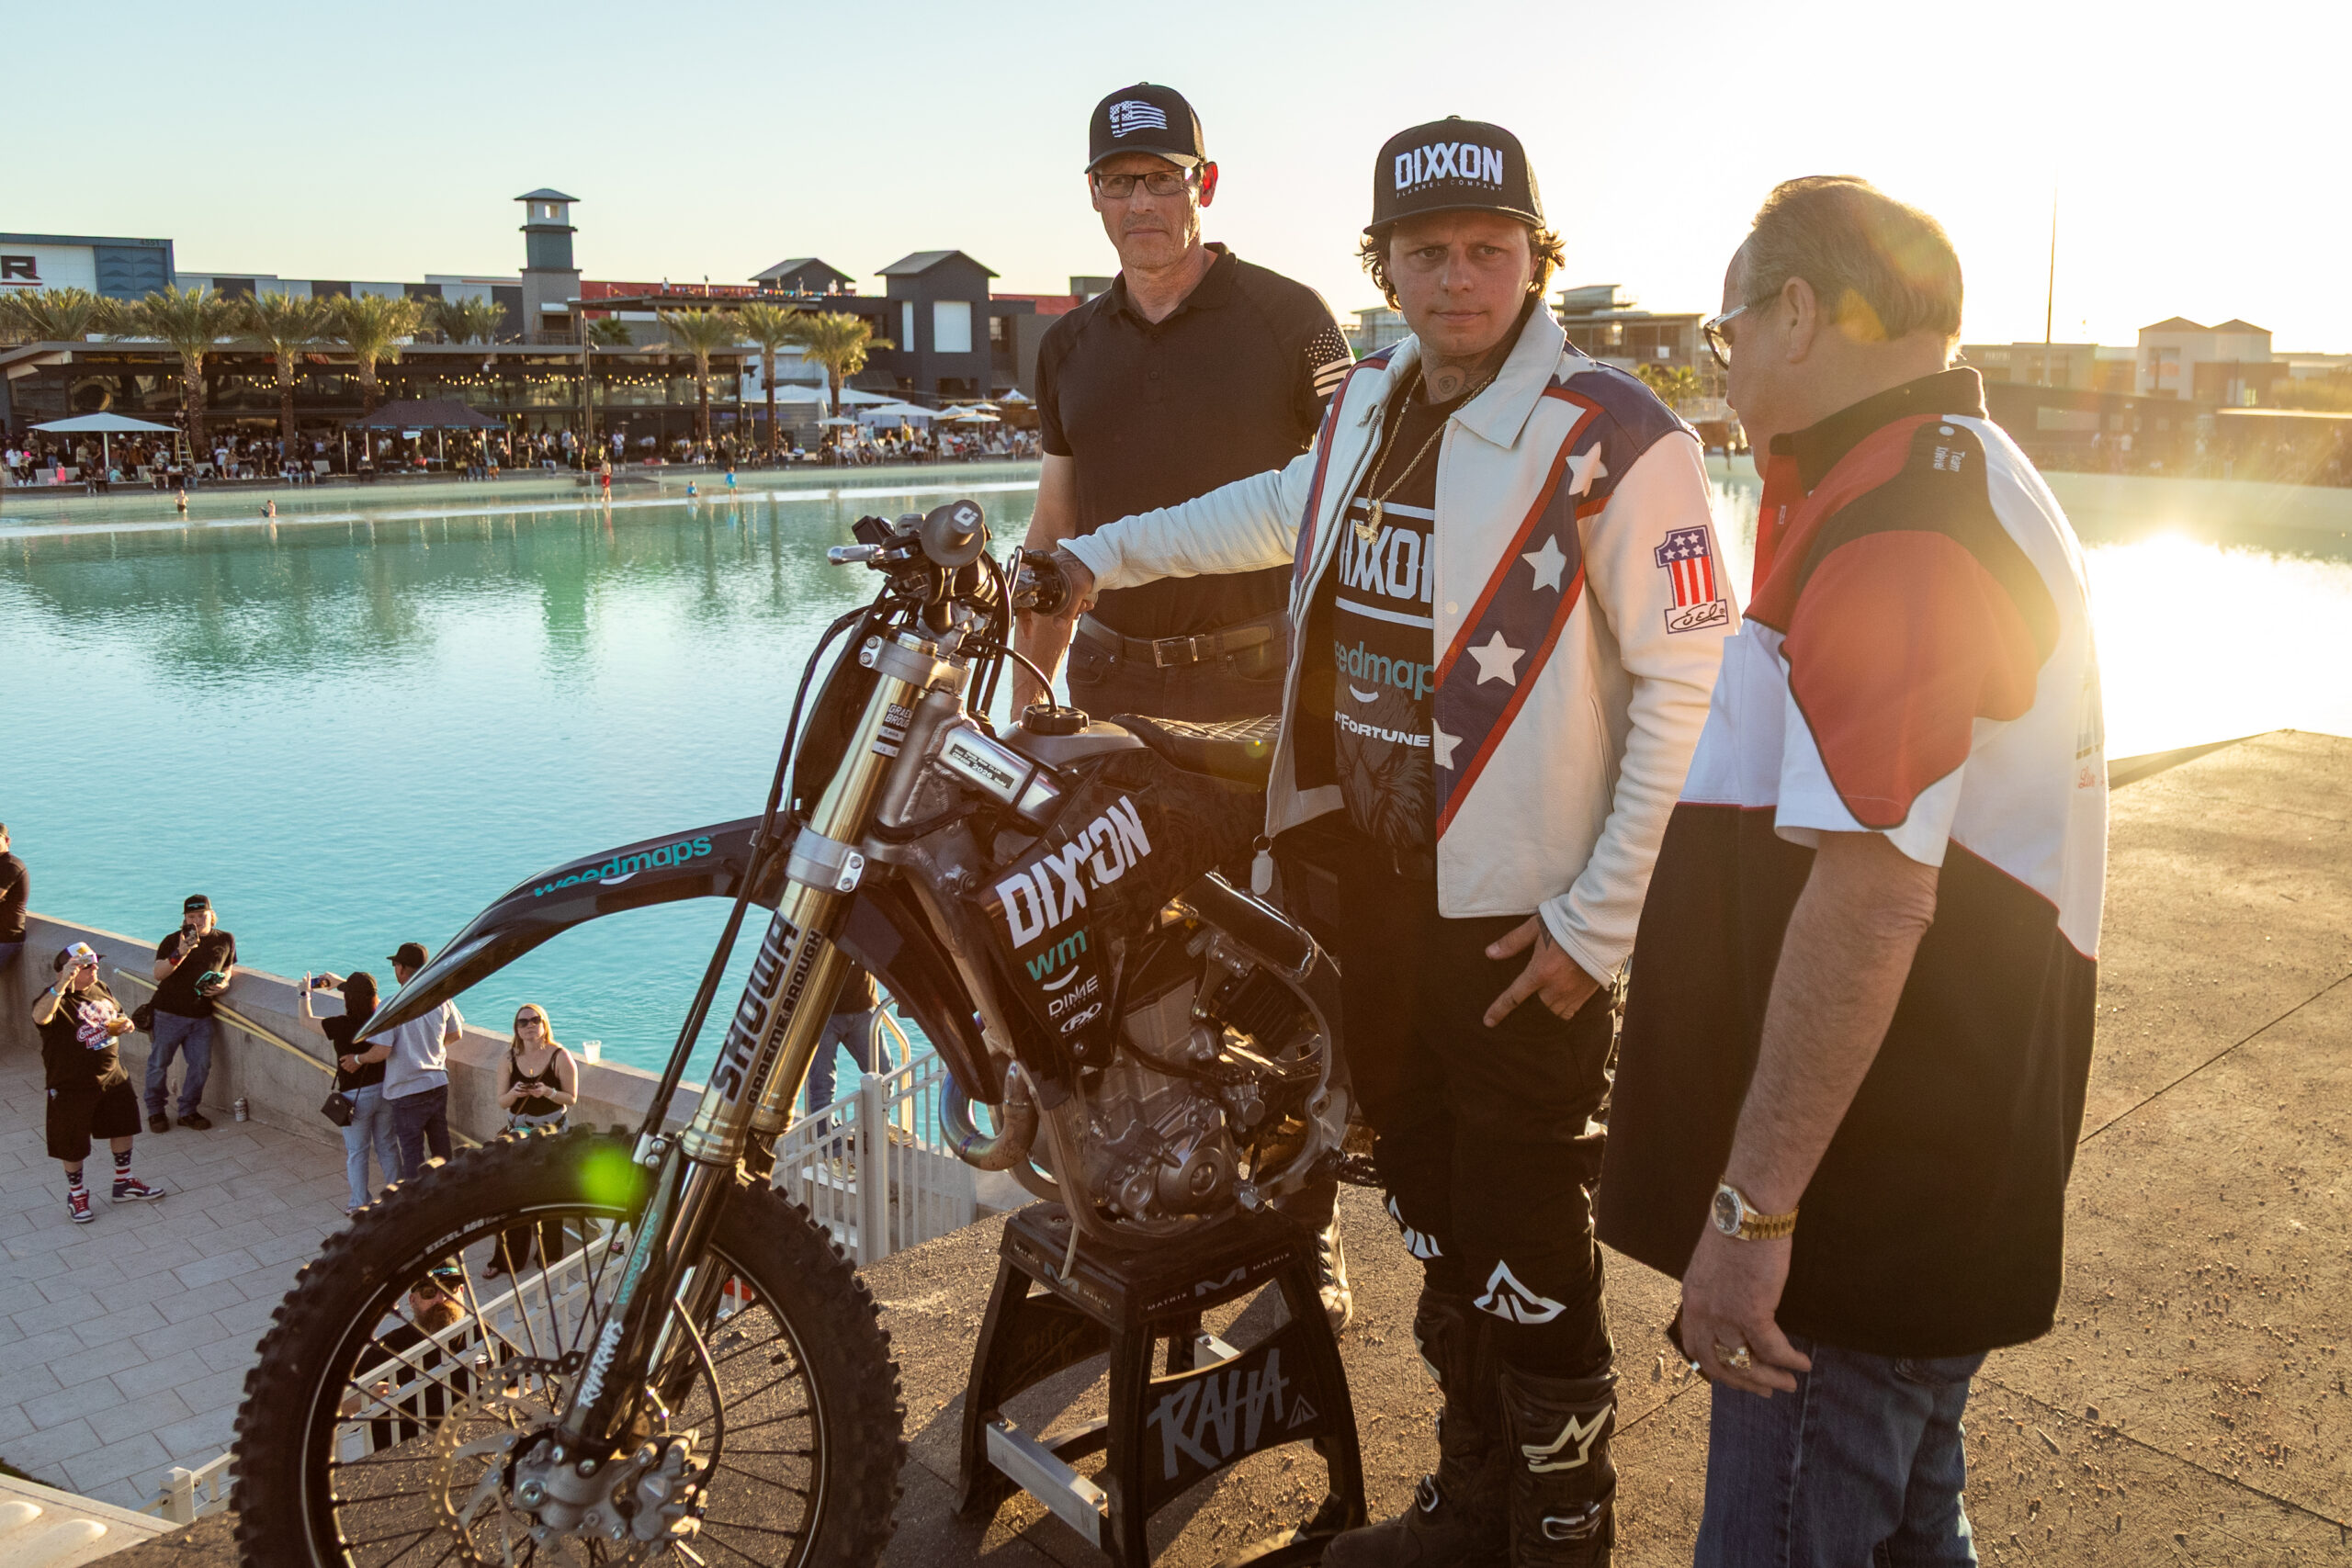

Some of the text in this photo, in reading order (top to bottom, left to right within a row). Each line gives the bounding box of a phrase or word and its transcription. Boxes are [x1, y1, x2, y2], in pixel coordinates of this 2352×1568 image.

[1395, 141, 1503, 191] DIXXON
[1396, 179, 1503, 198] FLANNEL COMPANY
[534, 836, 715, 897] weedmaps
[711, 907, 801, 1106] SHOWA
[746, 928, 823, 1106] GRAEME BROUGH
[1048, 975, 1099, 1017] DIME
[617, 1211, 659, 1305] weedmaps
[1148, 1292, 1187, 1311] MATRIX
[1252, 1252, 1290, 1270] MATRIX
